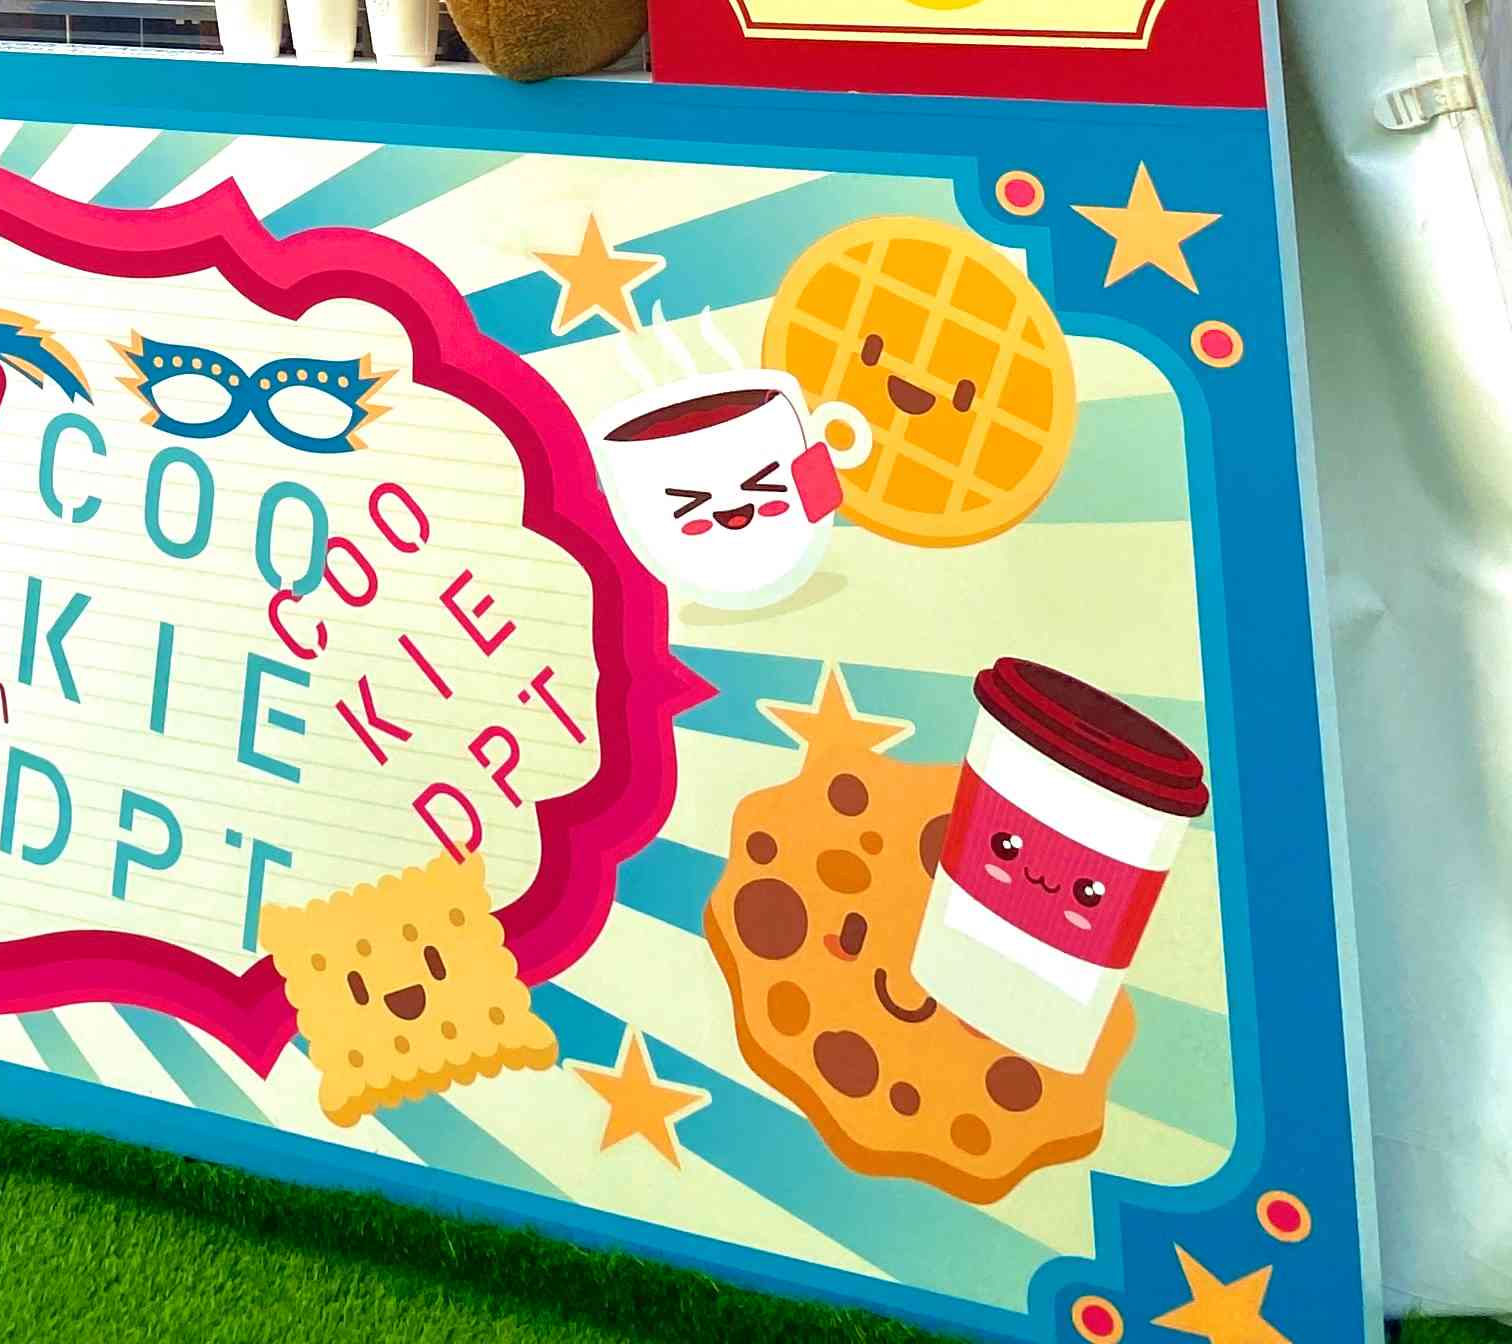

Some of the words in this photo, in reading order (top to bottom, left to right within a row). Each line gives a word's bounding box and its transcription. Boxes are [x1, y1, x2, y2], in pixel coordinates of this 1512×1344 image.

[39, 413, 329, 597] COO
[268, 482, 430, 660] COO
[18, 576, 311, 783] KIE
[335, 569, 515, 765] KIE
[412, 666, 586, 865] DPT
[0, 746, 292, 953] DPT
